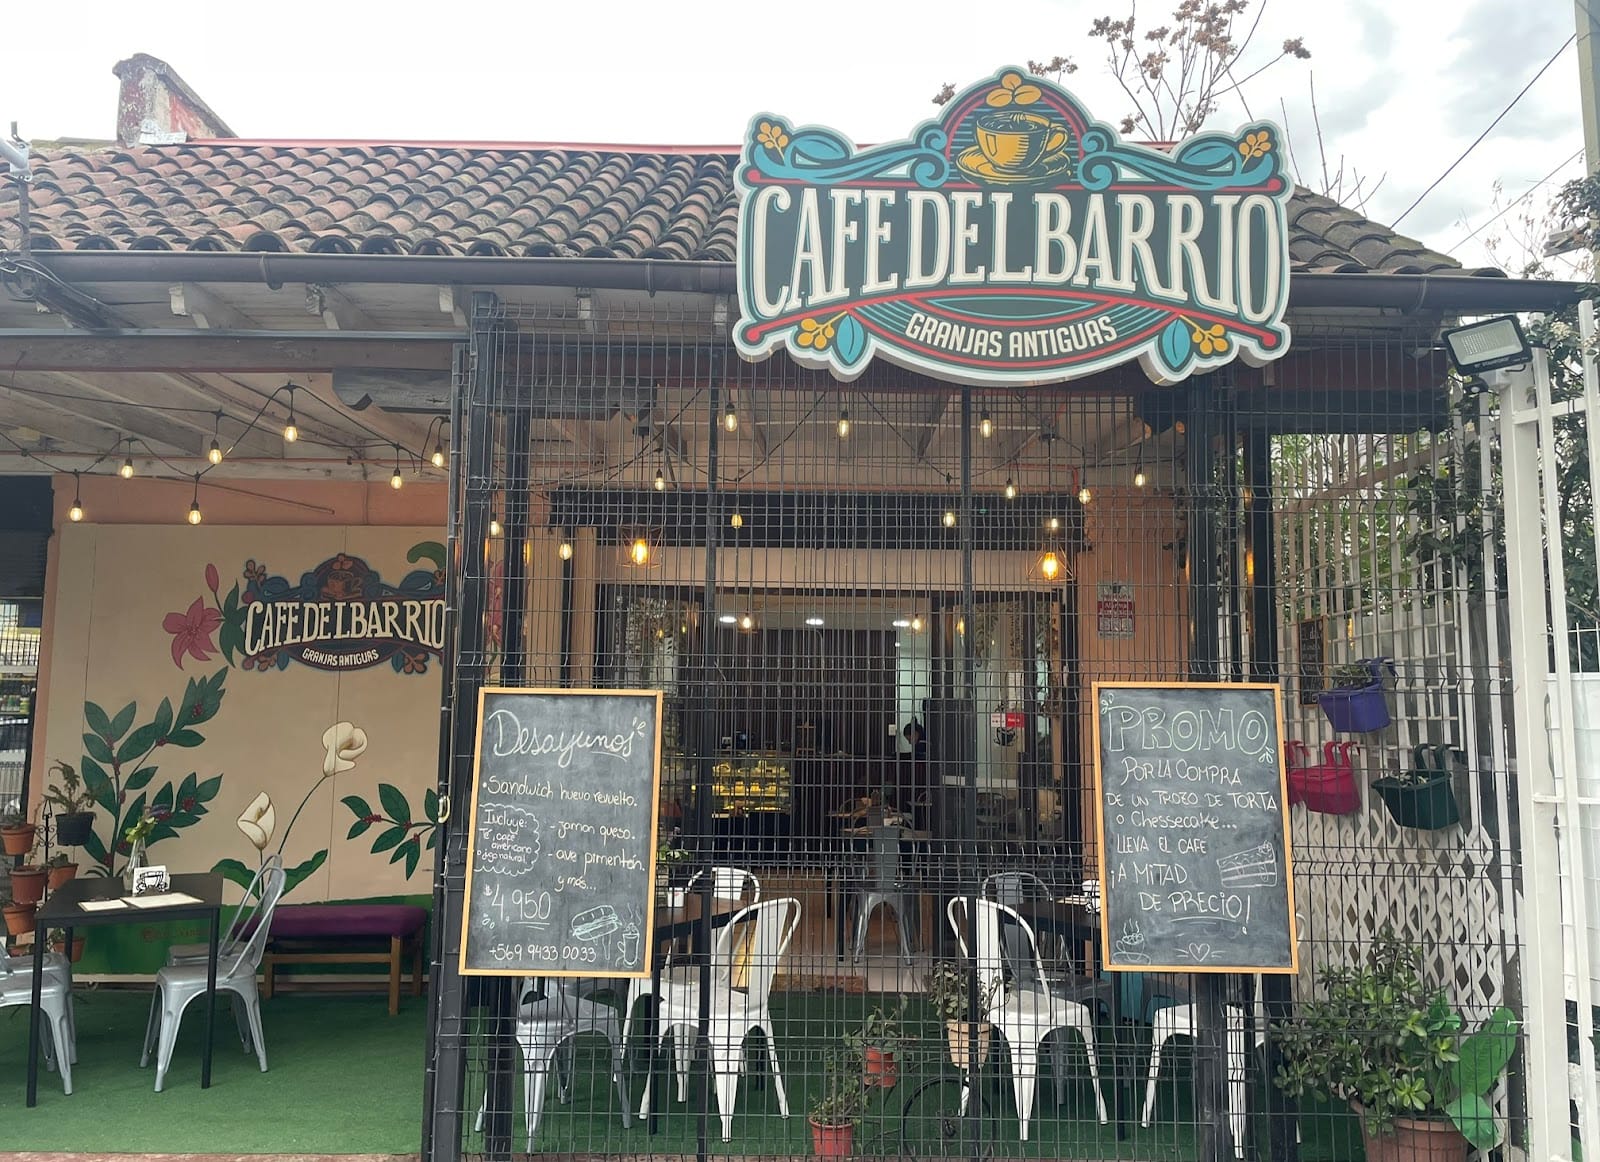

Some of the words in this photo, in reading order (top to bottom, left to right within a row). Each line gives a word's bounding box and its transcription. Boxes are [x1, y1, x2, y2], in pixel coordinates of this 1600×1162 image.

[753, 185, 898, 318] CAFE
[905, 190, 1032, 287] DEL
[1032, 193, 1281, 322] BARRIO
[905, 312, 1003, 358] GRANJAS
[1009, 315, 1118, 358] ANTIGUAS
[245, 600, 301, 656] CAFE
[302, 601, 350, 642] DEL
[350, 600, 446, 650] BARRIO
[302, 648, 338, 667] GRANJAS
[338, 649, 380, 667] ANTIGUAS
[488, 709, 635, 768] Desayunos
[1106, 705, 1269, 755] PROMO
[1158, 759, 1172, 779] LA
[1175, 758, 1243, 786] COMPRA
[560, 781, 591, 801] huevo
[1106, 792, 1124, 807] DE
[1131, 794, 1150, 808] UN
[1152, 790, 1199, 806] TROZO
[1204, 793, 1223, 807] DE
[1227, 791, 1278, 812] TORTA
[1117, 834, 1150, 854] LLEVA
[1159, 837, 1173, 854] EL
[556, 849, 577, 862] ave
[554, 875, 565, 892] y
[1138, 891, 1162, 912] DE
[489, 943, 523, 961] +569
[527, 944, 559, 961] 9433
[562, 945, 597, 963] 0033
